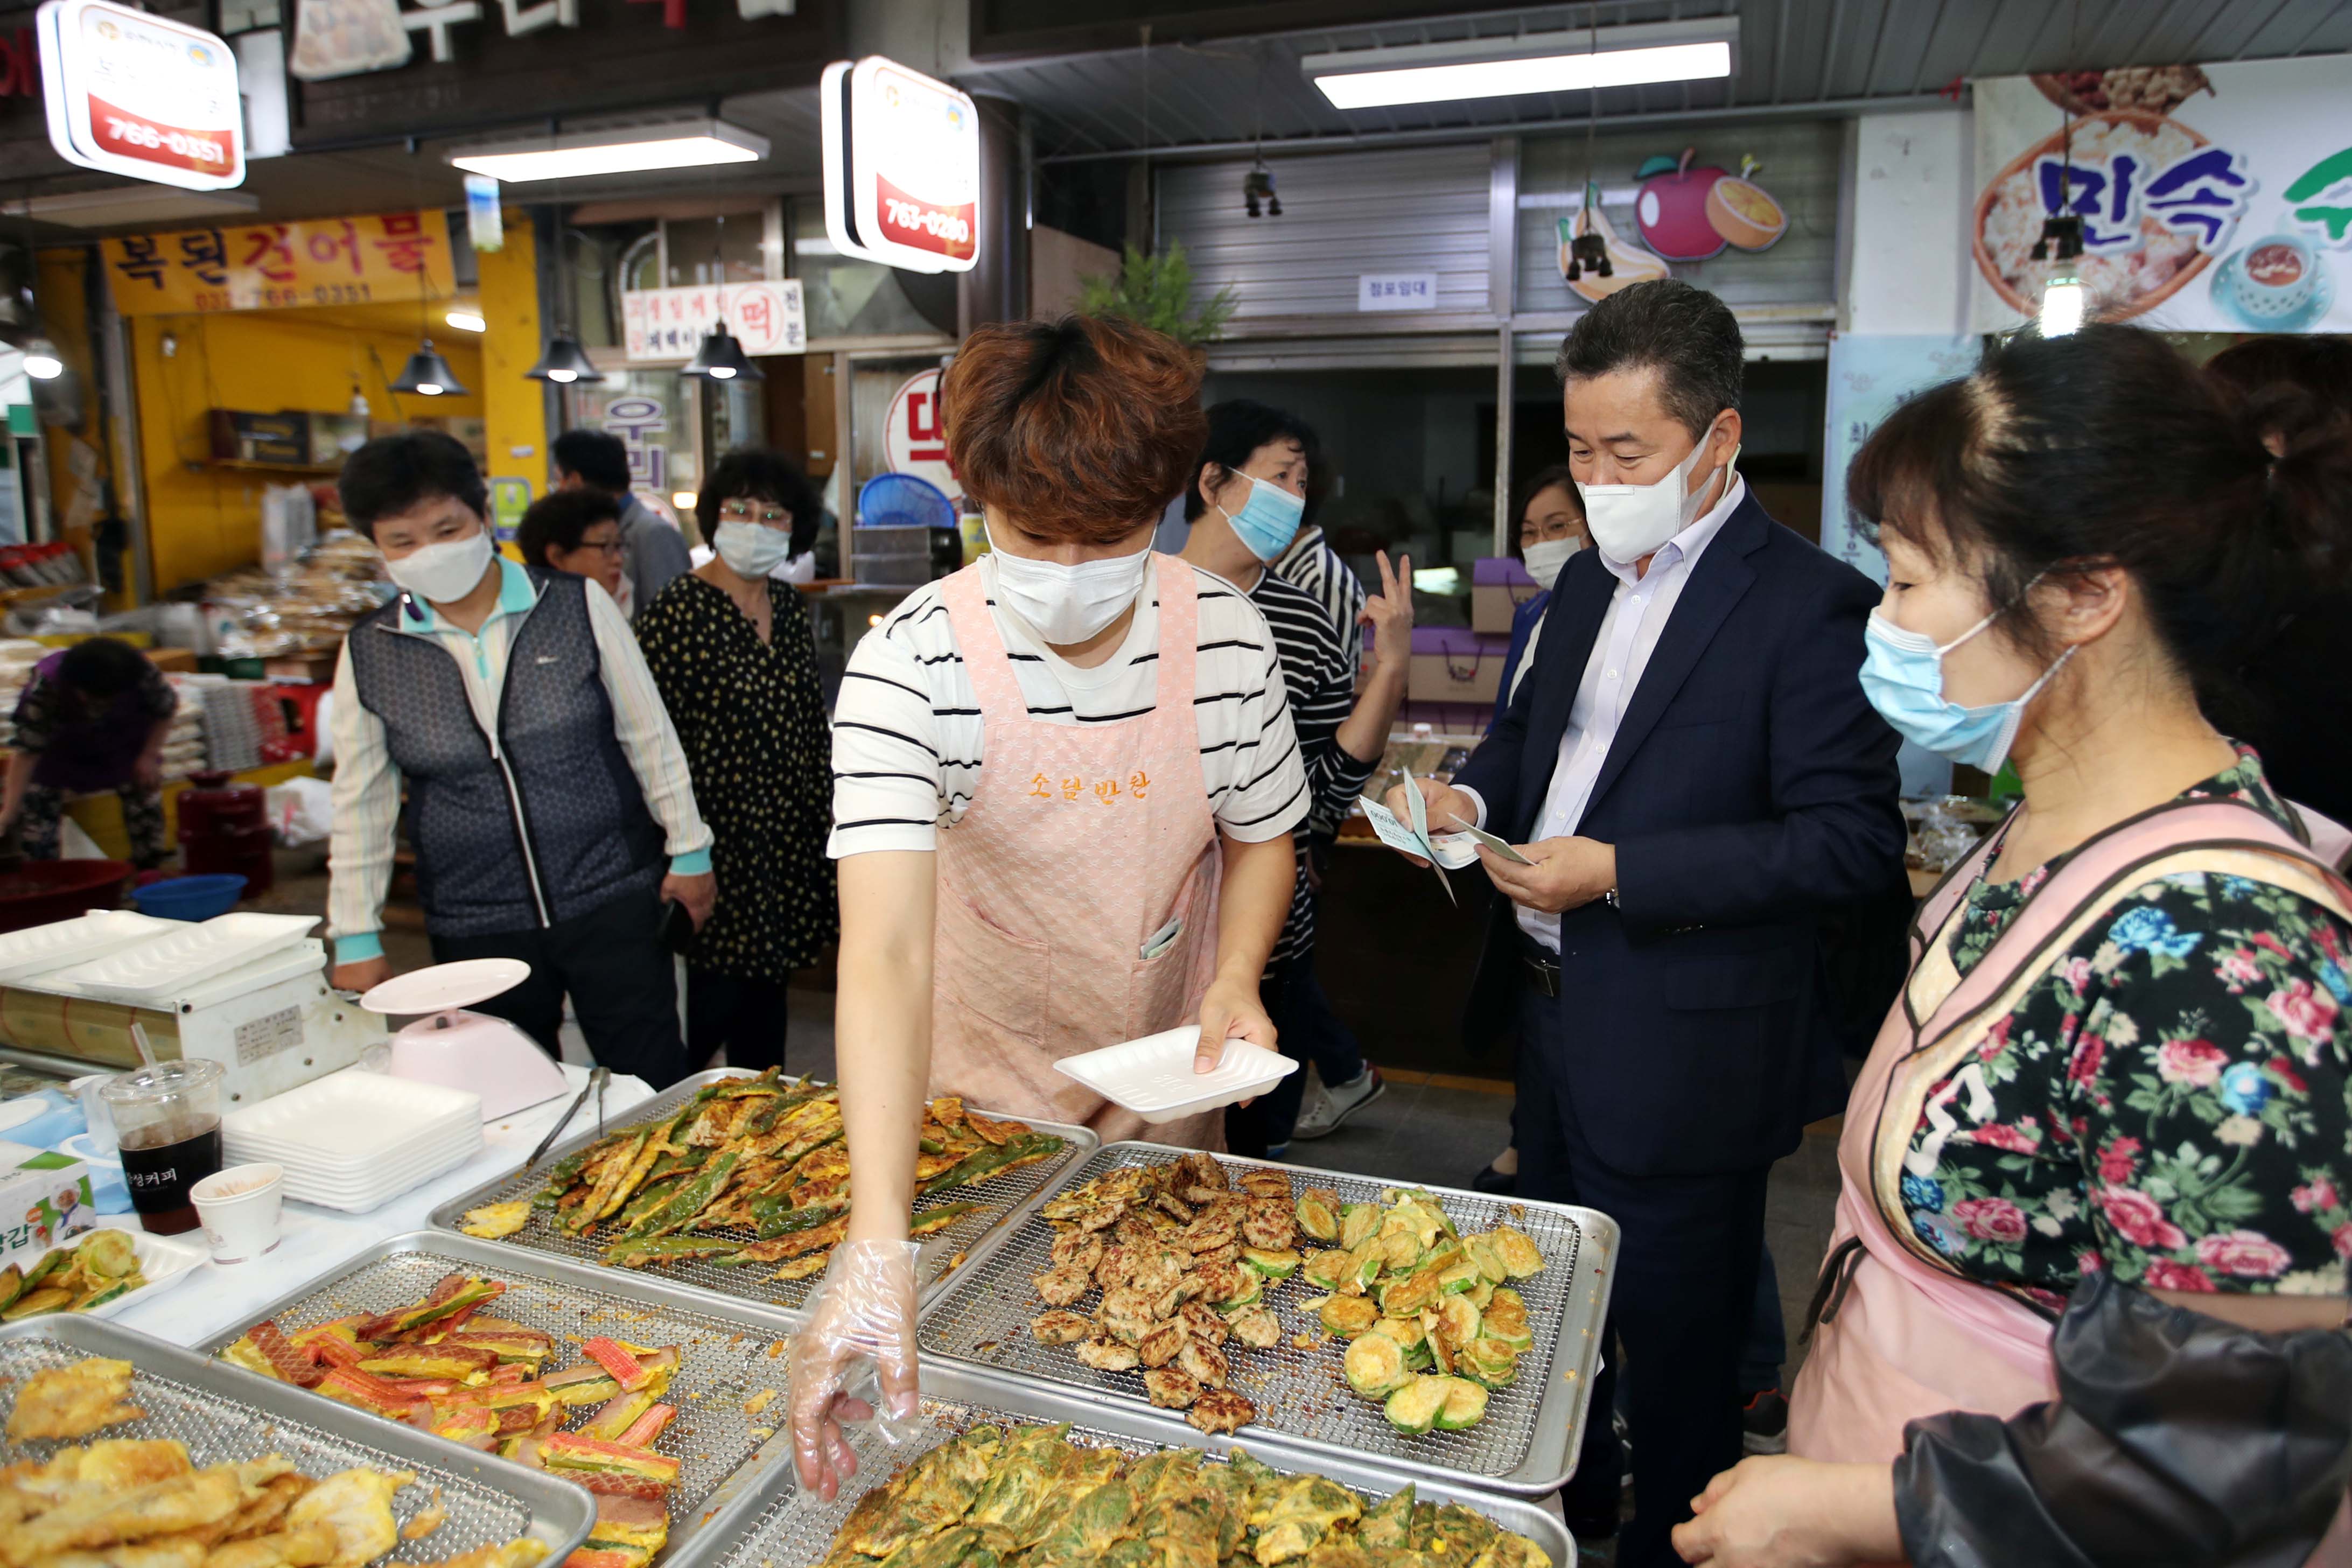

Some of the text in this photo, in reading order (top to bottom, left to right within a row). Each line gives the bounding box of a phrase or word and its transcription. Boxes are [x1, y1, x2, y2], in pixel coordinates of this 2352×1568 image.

[103, 115, 224, 165] 766-0351
[2039, 149, 2246, 248] 민속
[741, 296, 771, 340] 떡
